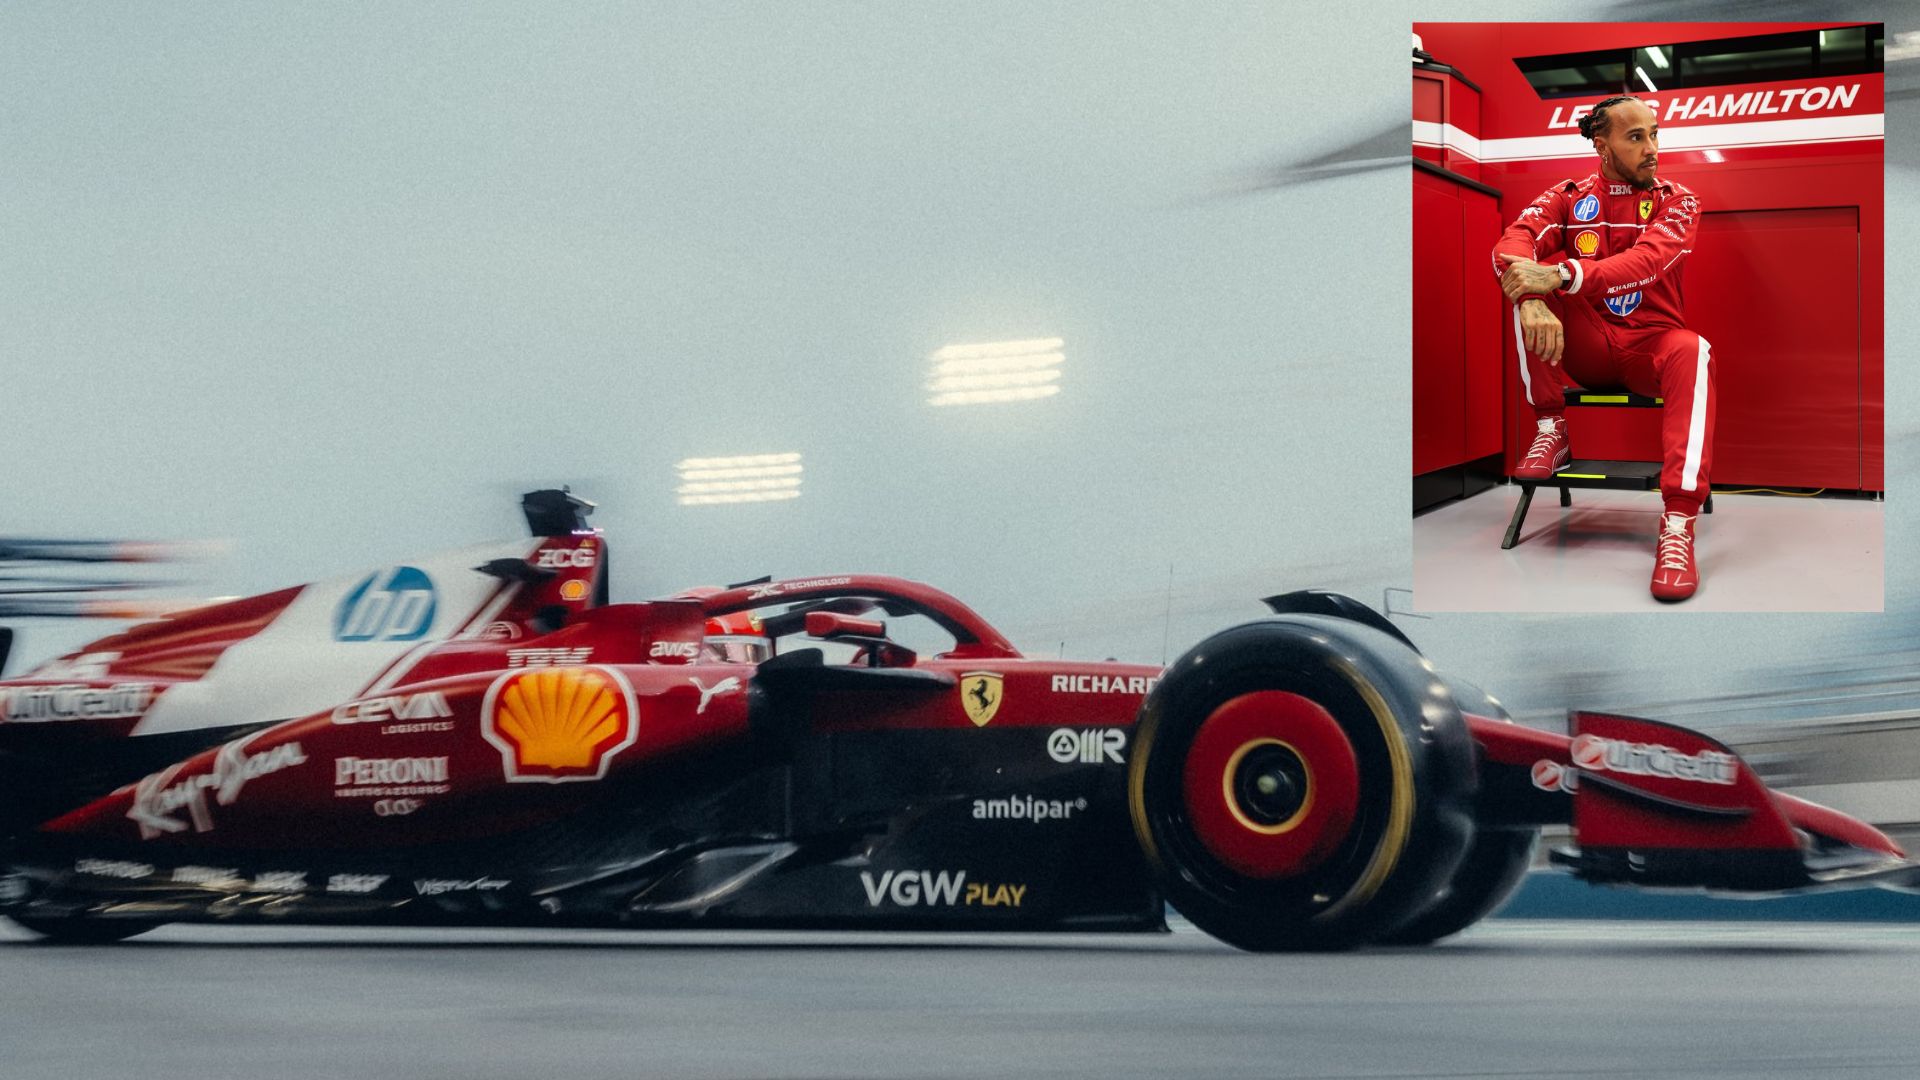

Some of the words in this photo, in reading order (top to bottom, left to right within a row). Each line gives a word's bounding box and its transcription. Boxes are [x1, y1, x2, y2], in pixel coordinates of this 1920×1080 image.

[1548, 100, 1660, 129] LES
[1664, 84, 1861, 121] HAMILTON
[1609, 185, 1633, 195] IBM
[1576, 195, 1597, 221] hp
[1607, 281, 1638, 294] RICHARD
[783, 577, 851, 590] TECHNOLOGY
[336, 567, 436, 641] hp
[649, 641, 699, 657] aws
[381, 721, 454, 735] LOGISTICS
[334, 756, 449, 785] PERONI
[859, 870, 966, 907] VGW
[965, 883, 1026, 907] PLAY
